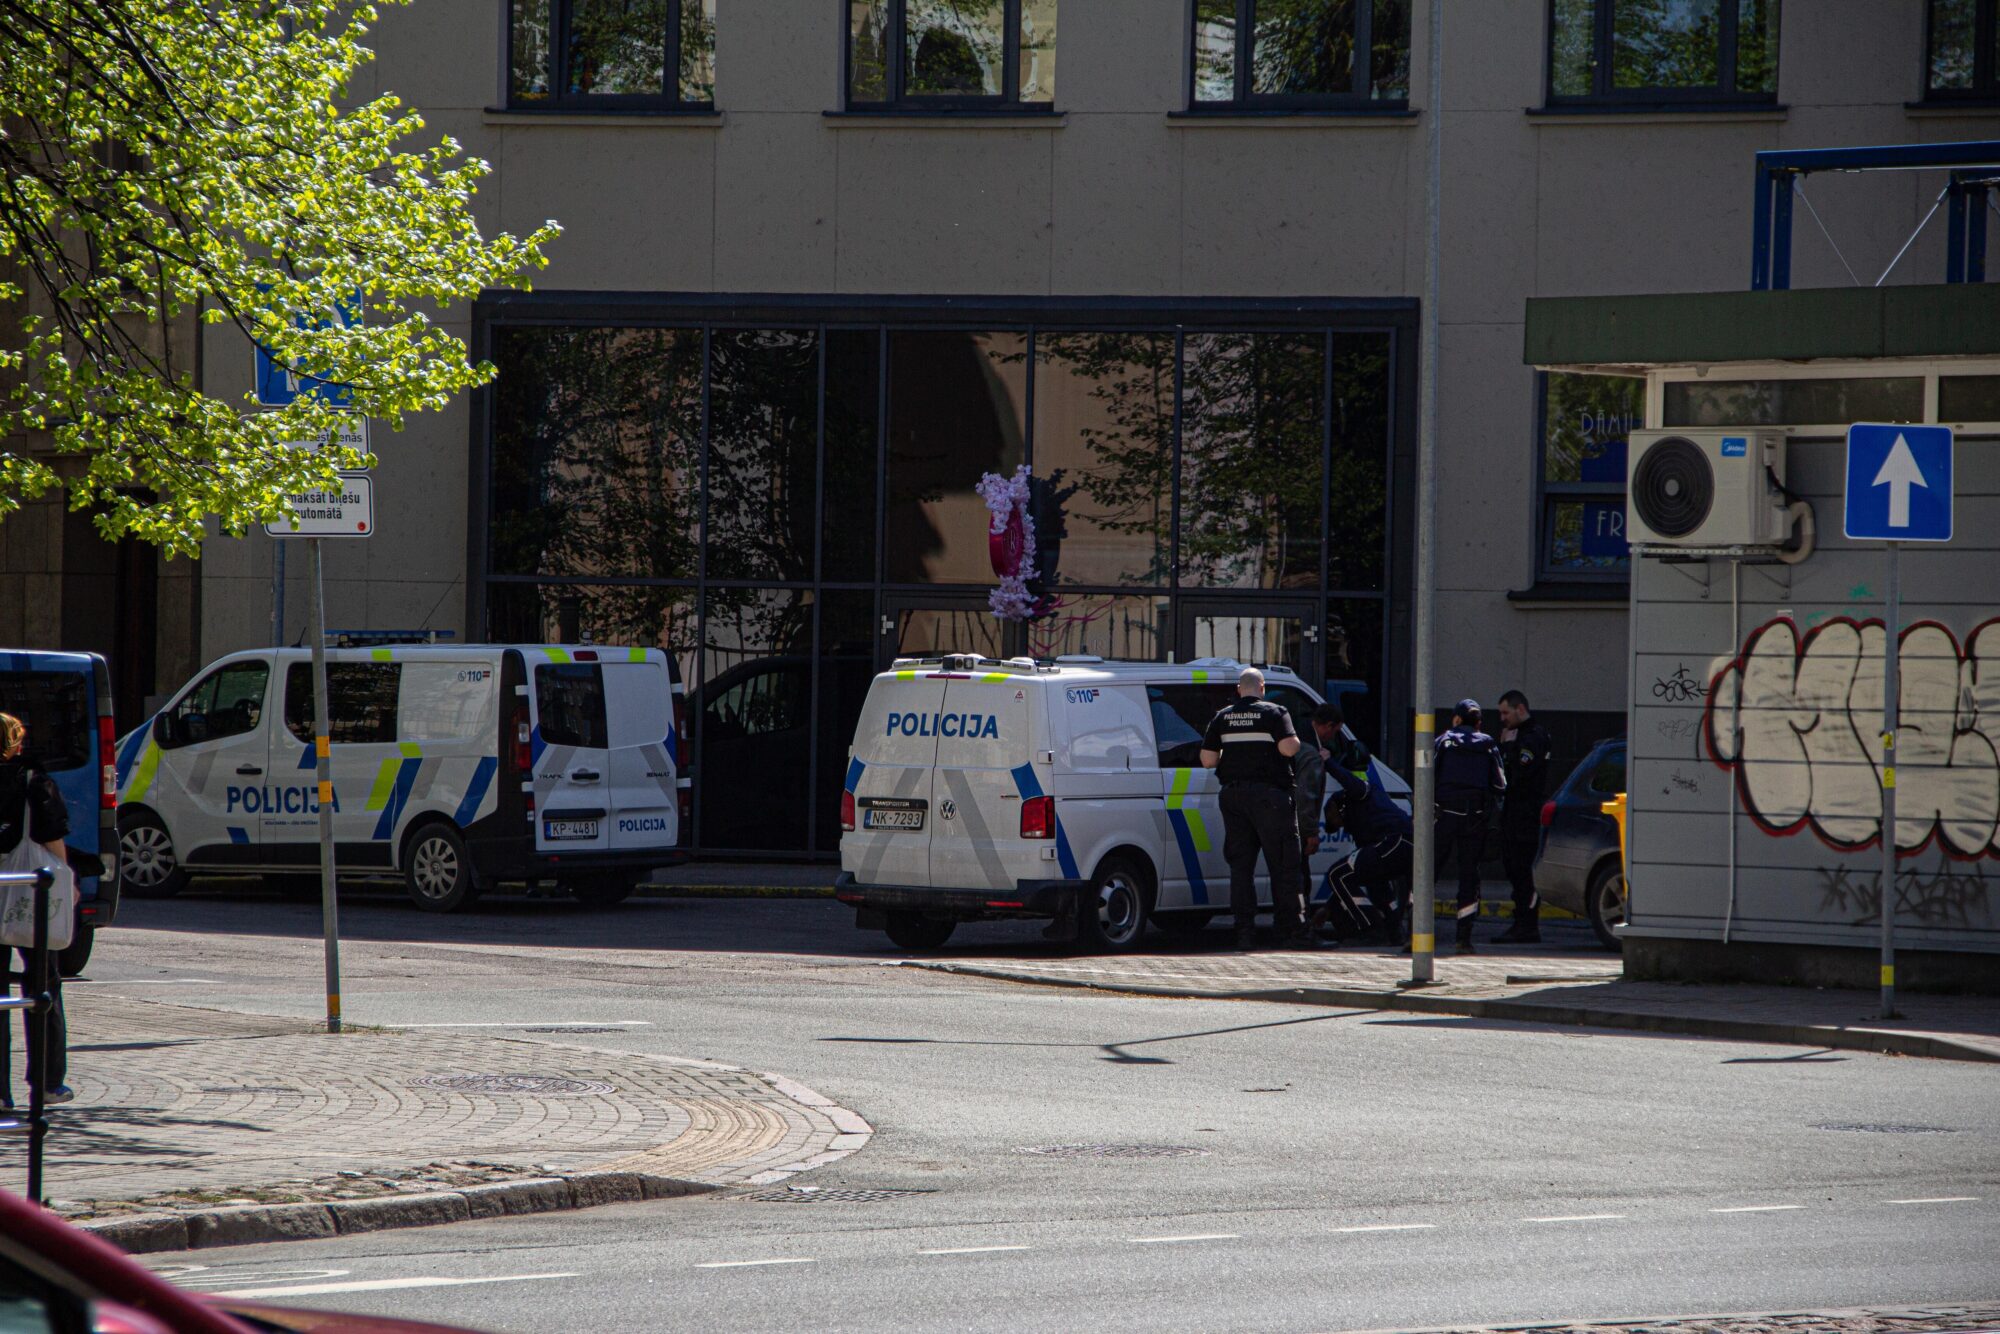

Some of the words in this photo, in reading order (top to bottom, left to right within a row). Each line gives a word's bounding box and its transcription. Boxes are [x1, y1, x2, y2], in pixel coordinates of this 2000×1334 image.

[310, 432, 363, 442] estenās
[467, 670, 482, 682] 110
[1076, 690, 1094, 703] 110
[1223, 711, 1261, 720] PAŠVALDĪBAS
[887, 712, 999, 739] POLICIJA
[619, 818, 667, 832] POLICIJA
[872, 811, 921, 826] NK-7293
[552, 822, 595, 836] KP-4481
